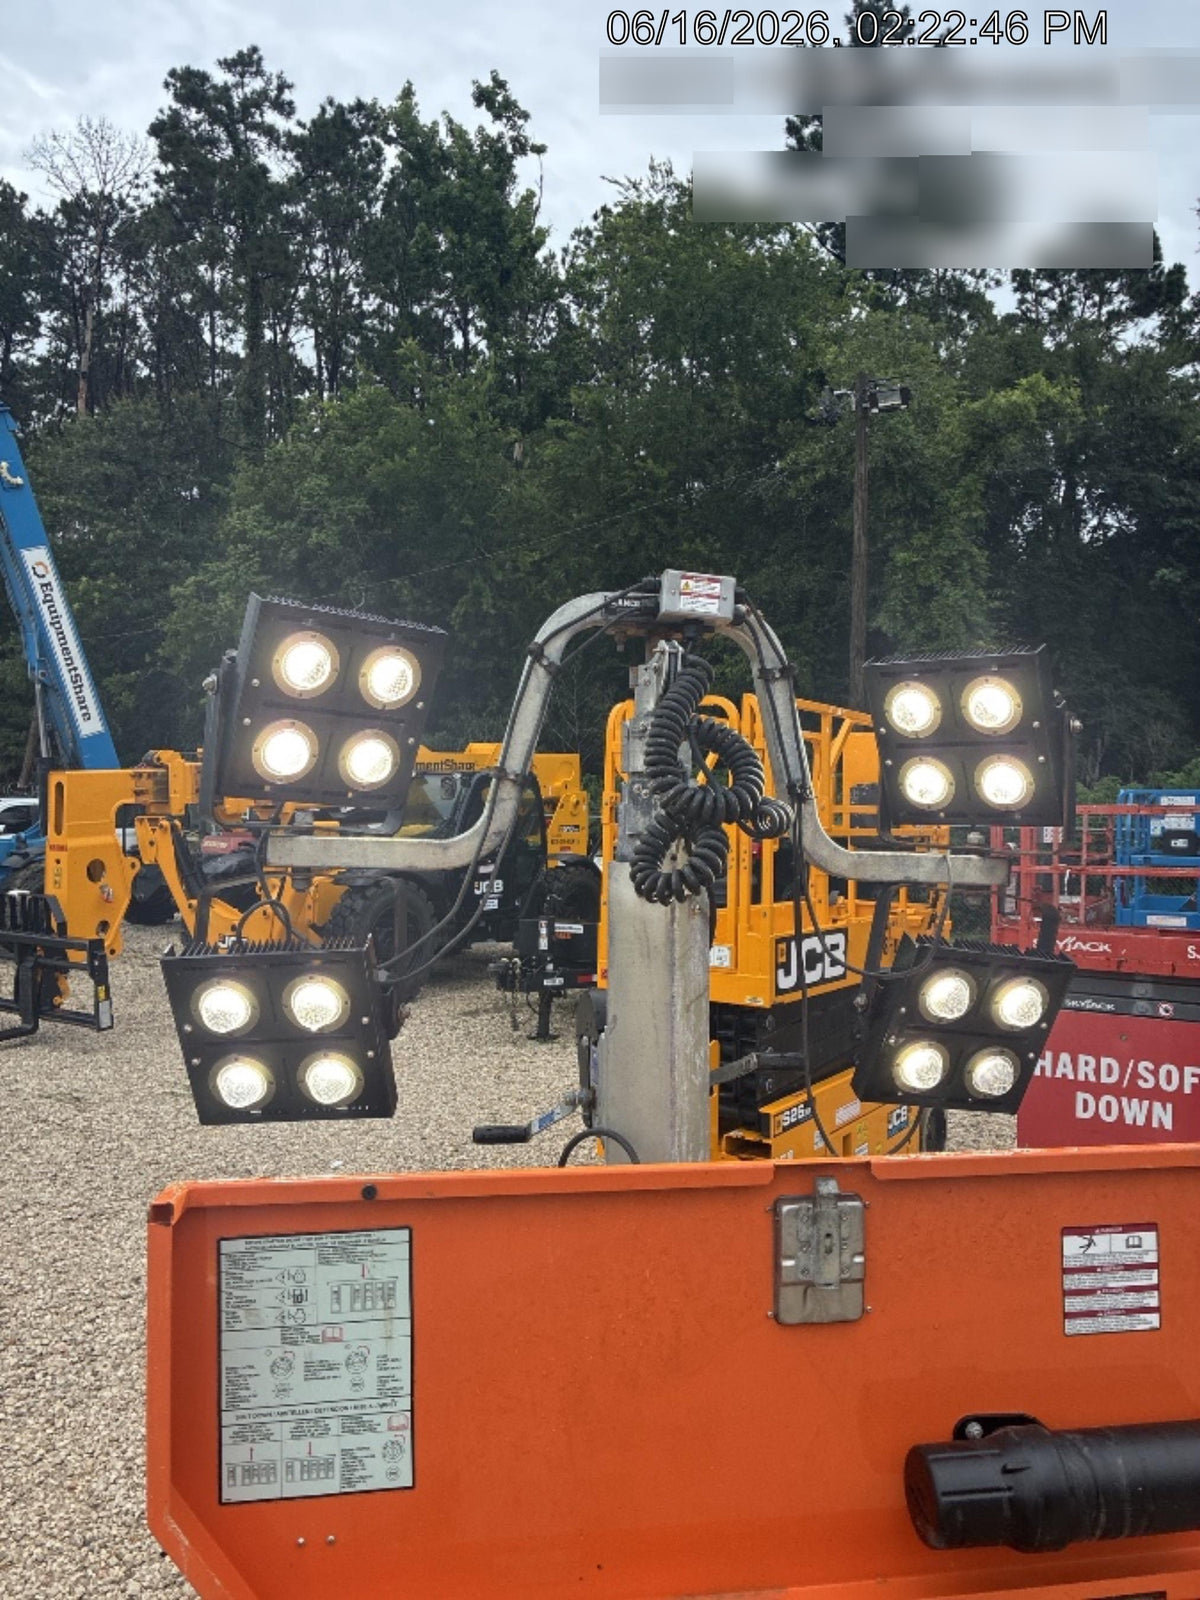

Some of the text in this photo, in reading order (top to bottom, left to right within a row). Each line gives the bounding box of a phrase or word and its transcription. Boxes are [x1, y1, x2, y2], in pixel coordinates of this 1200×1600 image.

[38, 582, 92, 723] EquipmentShare
[776, 932, 846, 990] JCB
[1075, 1091, 1173, 1131] DOWN
